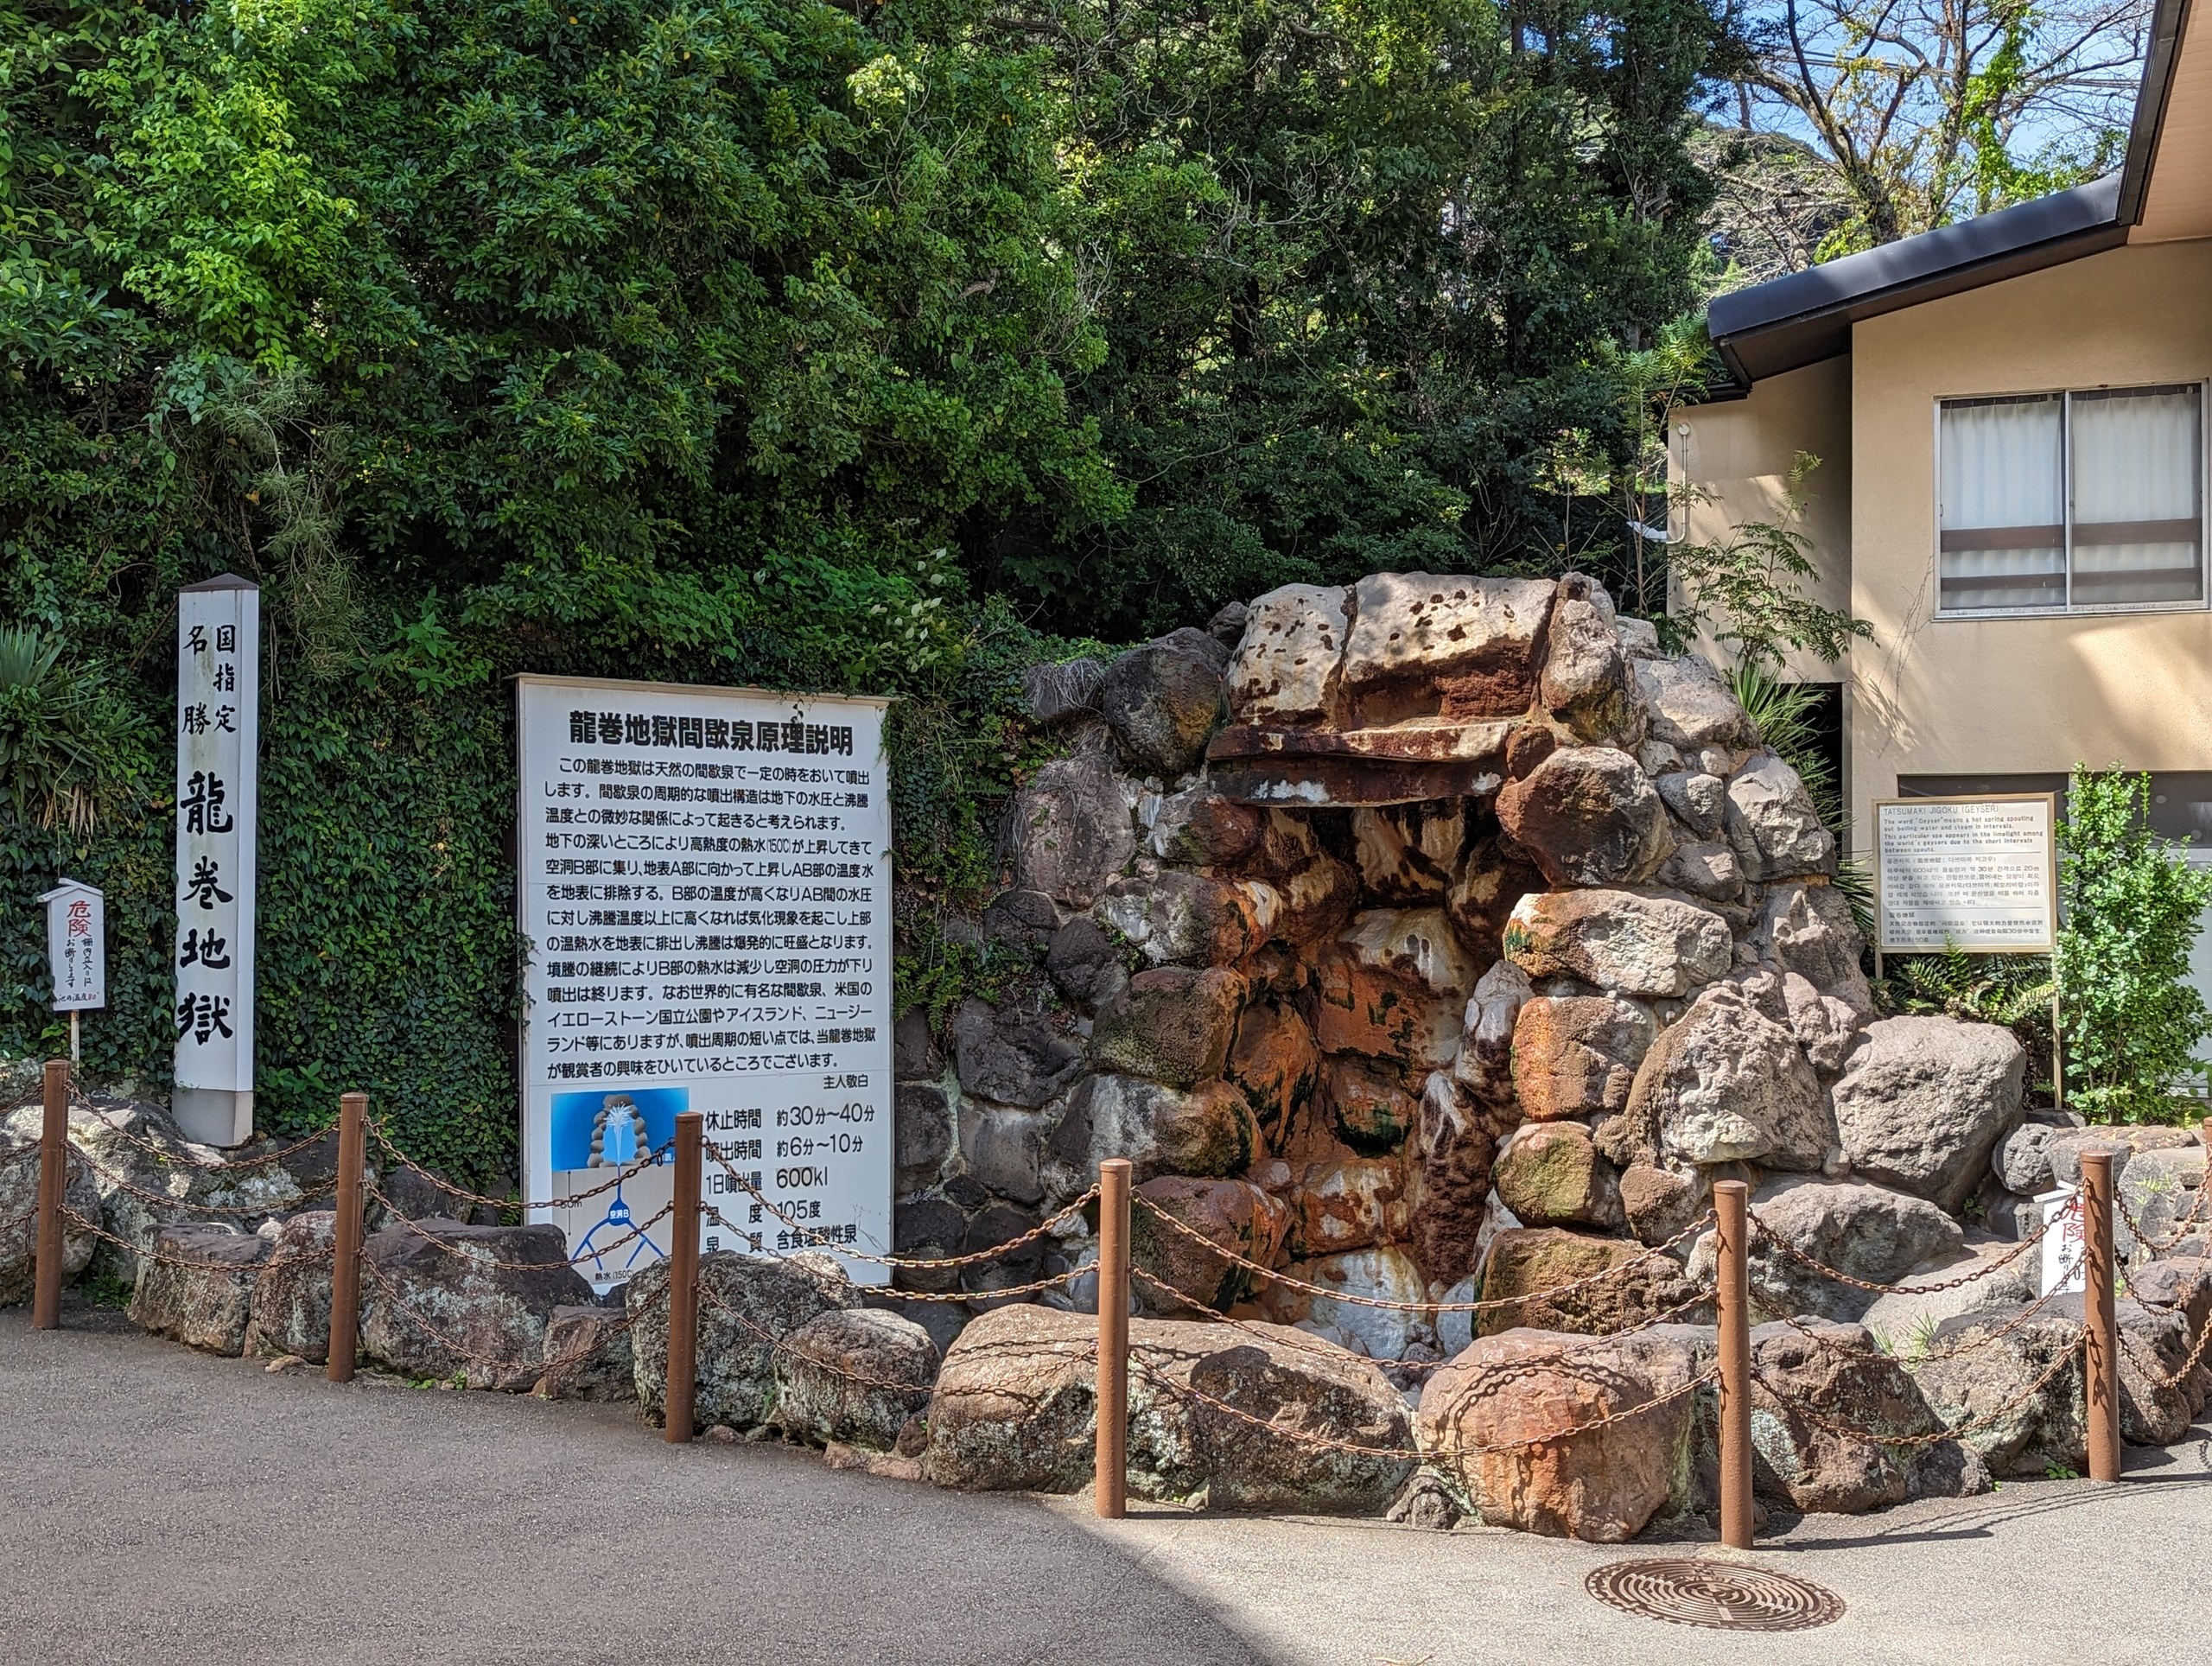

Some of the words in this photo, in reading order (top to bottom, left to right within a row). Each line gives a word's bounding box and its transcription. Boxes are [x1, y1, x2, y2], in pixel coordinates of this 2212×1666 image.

[182, 624, 212, 734] 名勝
[213, 624, 238, 734] 国指定
[569, 710, 854, 756] 龍巻地獄間歇泉原理説明
[559, 757, 870, 785] この龍巻地獄は天然の間歇泉で一定の時をおいて噴出
[544, 806, 846, 831] 温度との微妙な関係によって起きると考えられます。
[1884, 807, 1926, 816] TATSUMAKI
[1961, 804, 1999, 814] (GEYSER)
[67, 900, 92, 938] 危険
[177, 771, 234, 1046] 龍巻地獄
[547, 910, 872, 927] に対し沸騰温度以上に高くなれば気化現象を起こし上部
[546, 935, 873, 952] の温熱水を地表に排出し沸騰は爆発的に旺盛となります。
[546, 1004, 873, 1028] イエローストーン国立公園やアイスランド、ニュージー
[547, 1052, 837, 1080] が観賞者の興味をひいているところでございます。
[823, 1073, 868, 1089] 主人敬白
[705, 1108, 762, 1131] 休止時間
[776, 1199, 822, 1220] 105度
